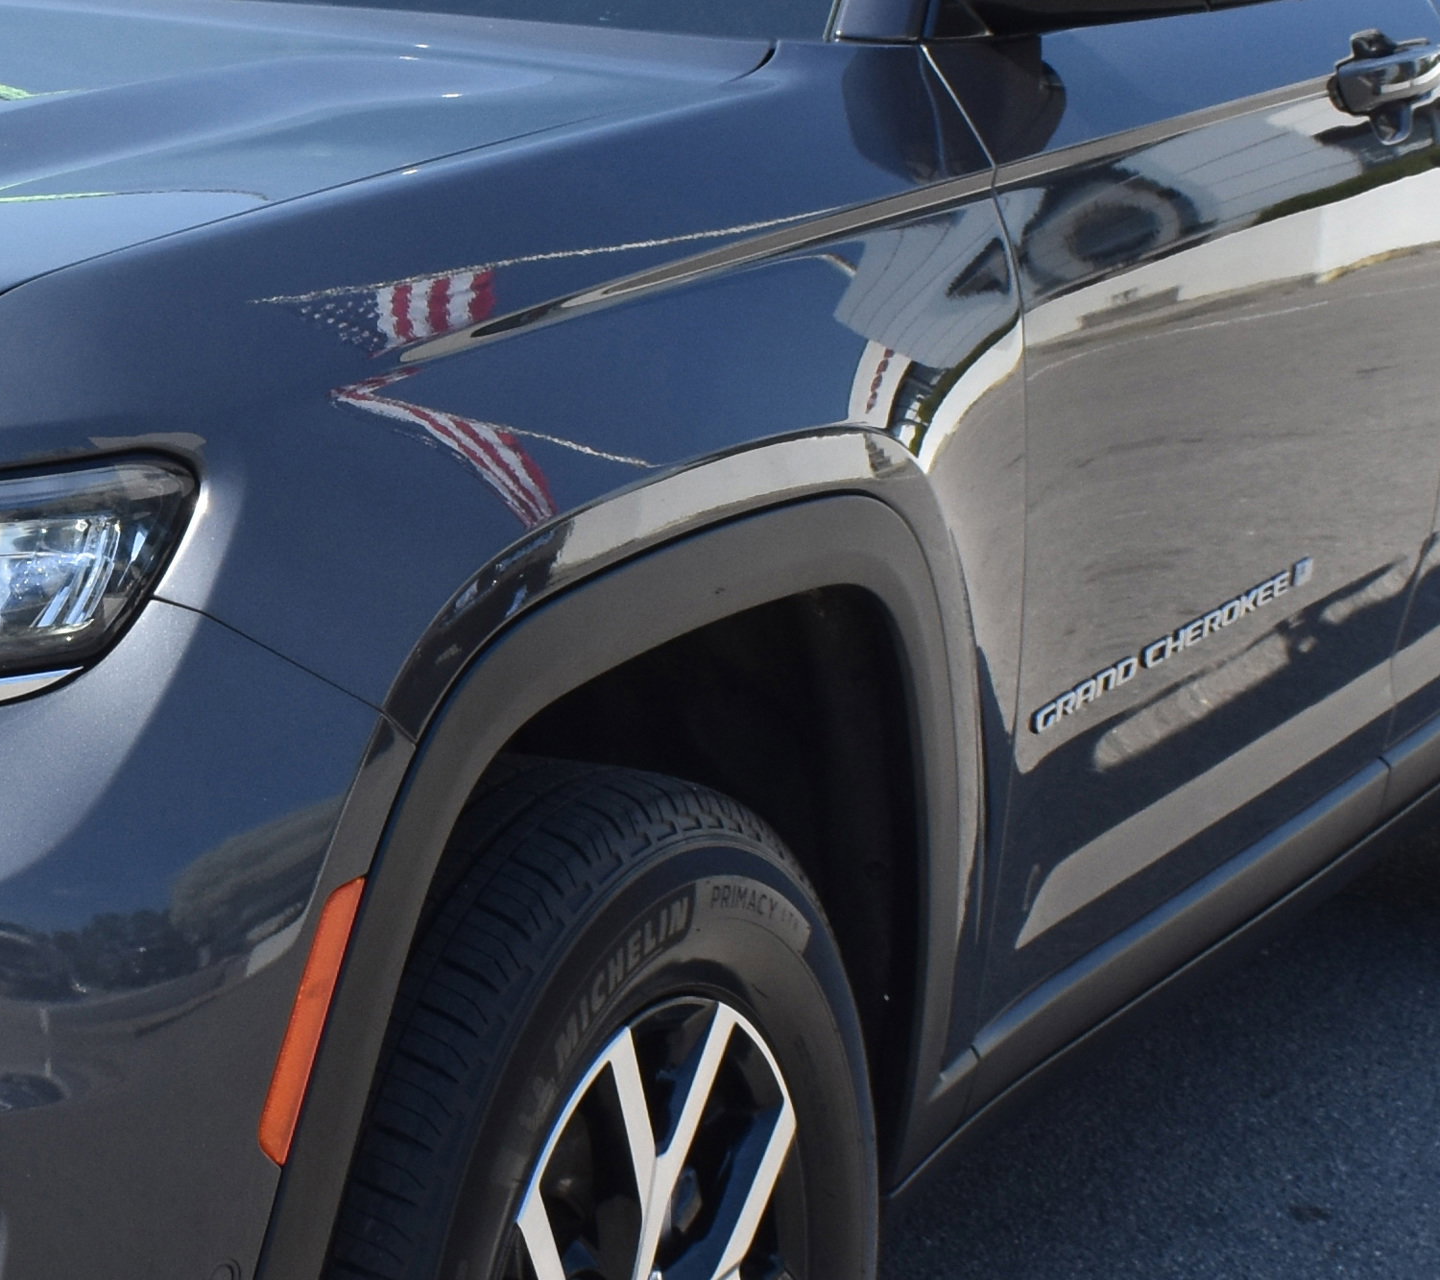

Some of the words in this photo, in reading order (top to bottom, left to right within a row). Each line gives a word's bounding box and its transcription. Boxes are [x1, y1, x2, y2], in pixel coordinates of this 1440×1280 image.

[1029, 655, 1138, 734] GRAND
[1141, 570, 1291, 670] CHEROKEE
[553, 893, 691, 1072] MICHELIN
[710, 884, 779, 919] PRIMACY
